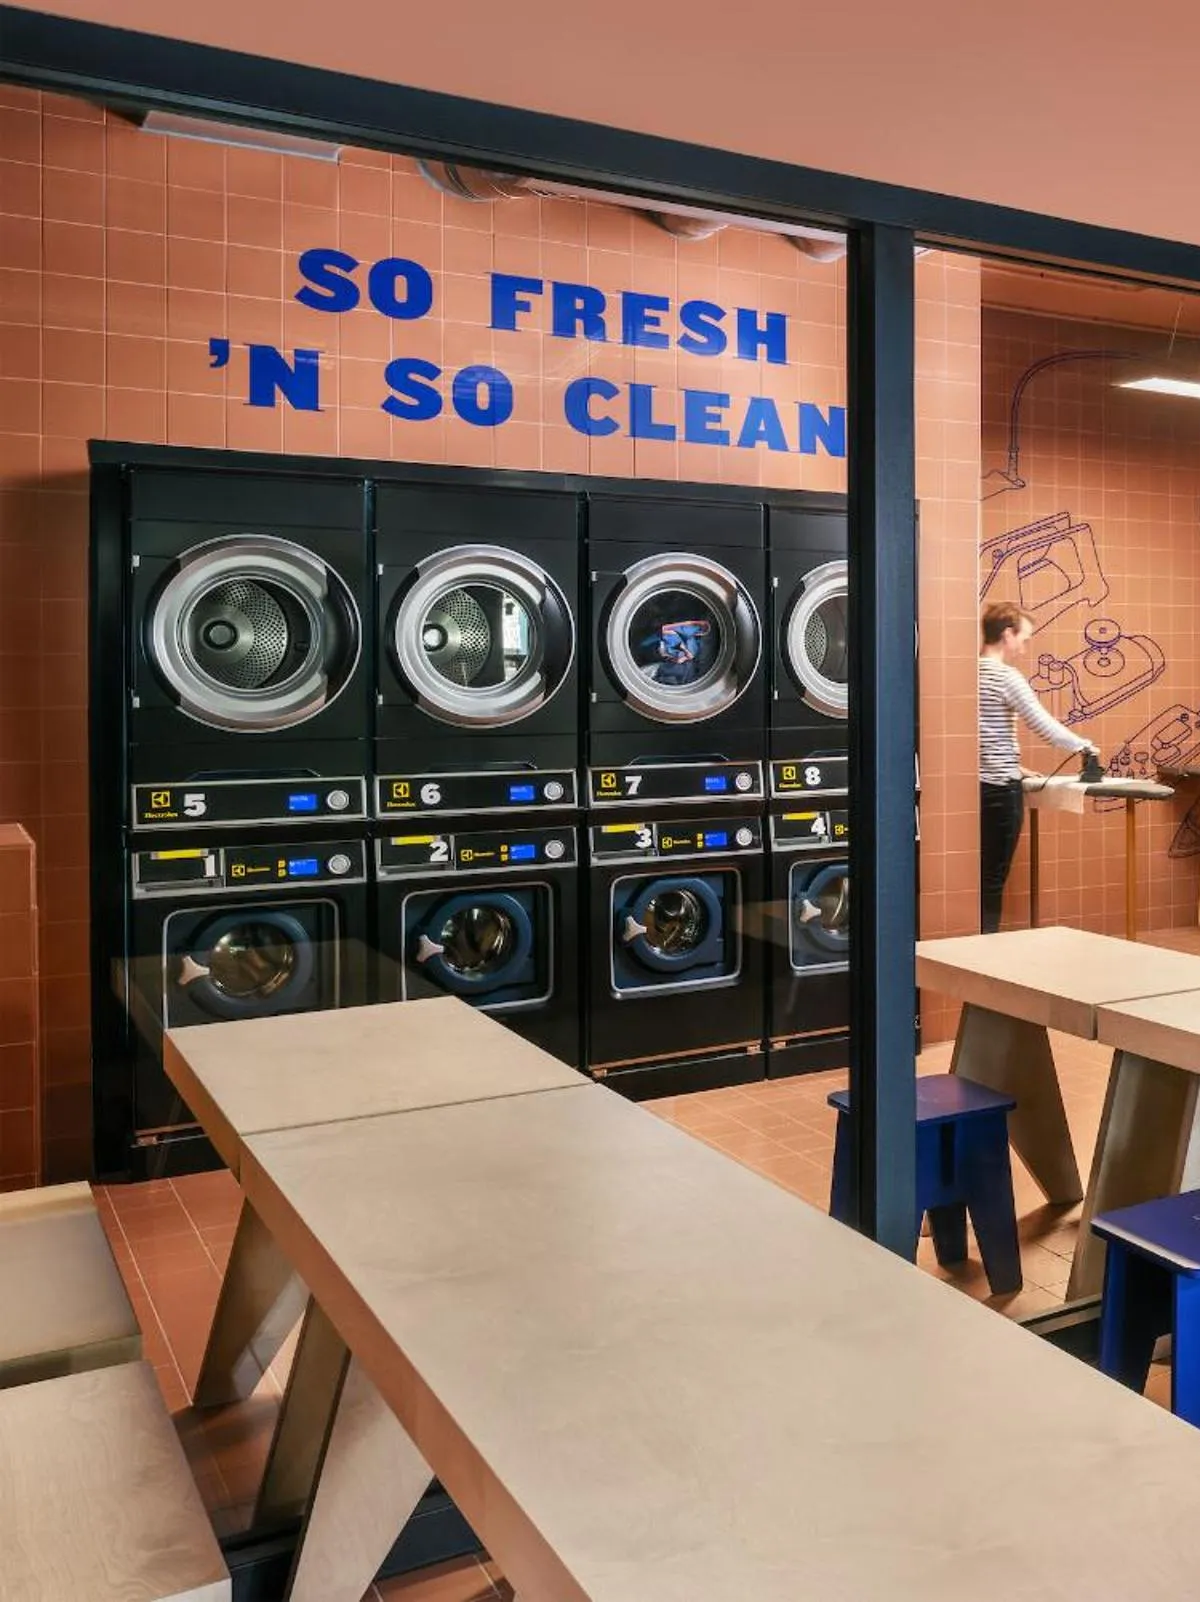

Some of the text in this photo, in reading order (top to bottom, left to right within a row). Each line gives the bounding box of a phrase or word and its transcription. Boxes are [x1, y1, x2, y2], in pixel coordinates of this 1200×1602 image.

[296, 249, 791, 365] SO FRESH
[382, 358, 513, 427] SO
[564, 377, 848, 458] CLEAN
[624, 775, 643, 795] 7
[804, 766, 822, 786] 8
[420, 782, 441, 805] 6
[183, 793, 208, 817] 5
[810, 817, 826, 836] 4
[634, 828, 653, 848] 3
[429, 841, 449, 862] 2
[202, 854, 216, 878] 1
